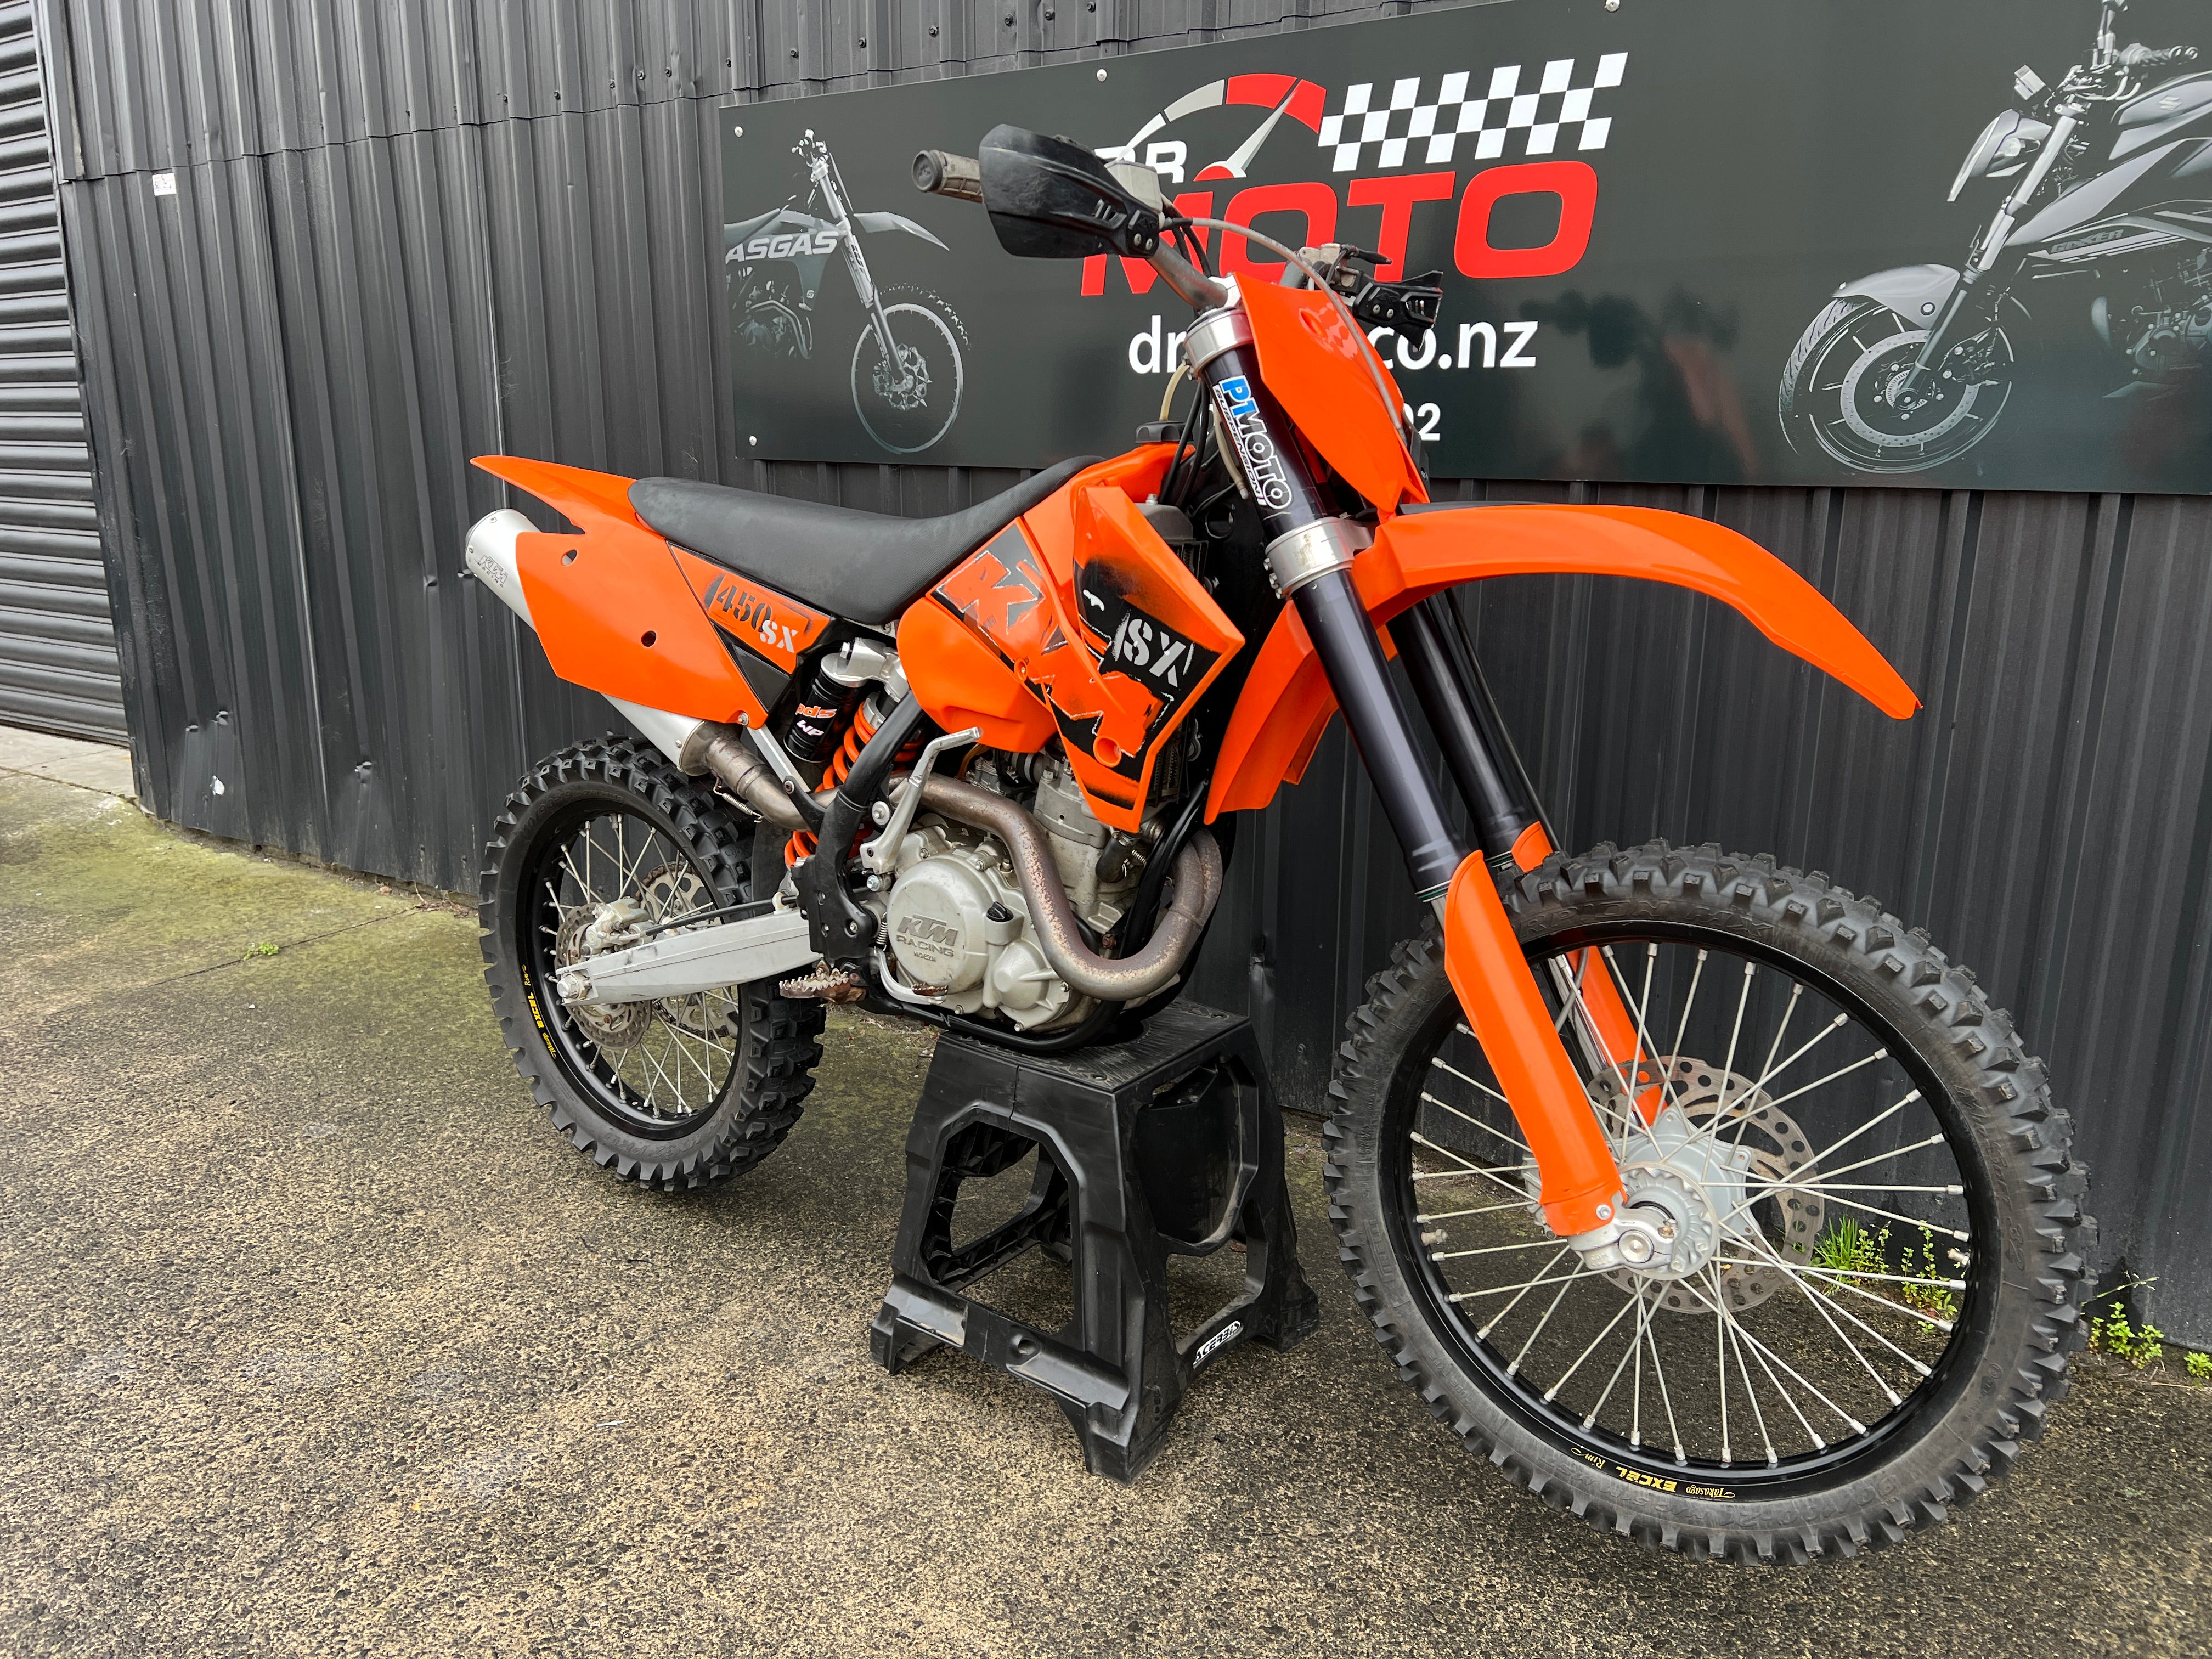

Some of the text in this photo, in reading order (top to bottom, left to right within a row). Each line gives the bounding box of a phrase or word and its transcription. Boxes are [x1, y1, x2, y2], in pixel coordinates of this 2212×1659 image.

[1081, 161, 1598, 296] MOTO
[480, 555, 507, 584] KTM
[760, 620, 798, 653] SX
[1124, 618, 1193, 687] SX
[797, 720, 824, 736] WP
[896, 934, 955, 957] RACING
[897, 913, 958, 946] KTM
[522, 964, 531, 986] Rim
[528, 992, 544, 1029] EXCEL
[1570, 1447, 1735, 1499] Takasago EXCEL Rim
